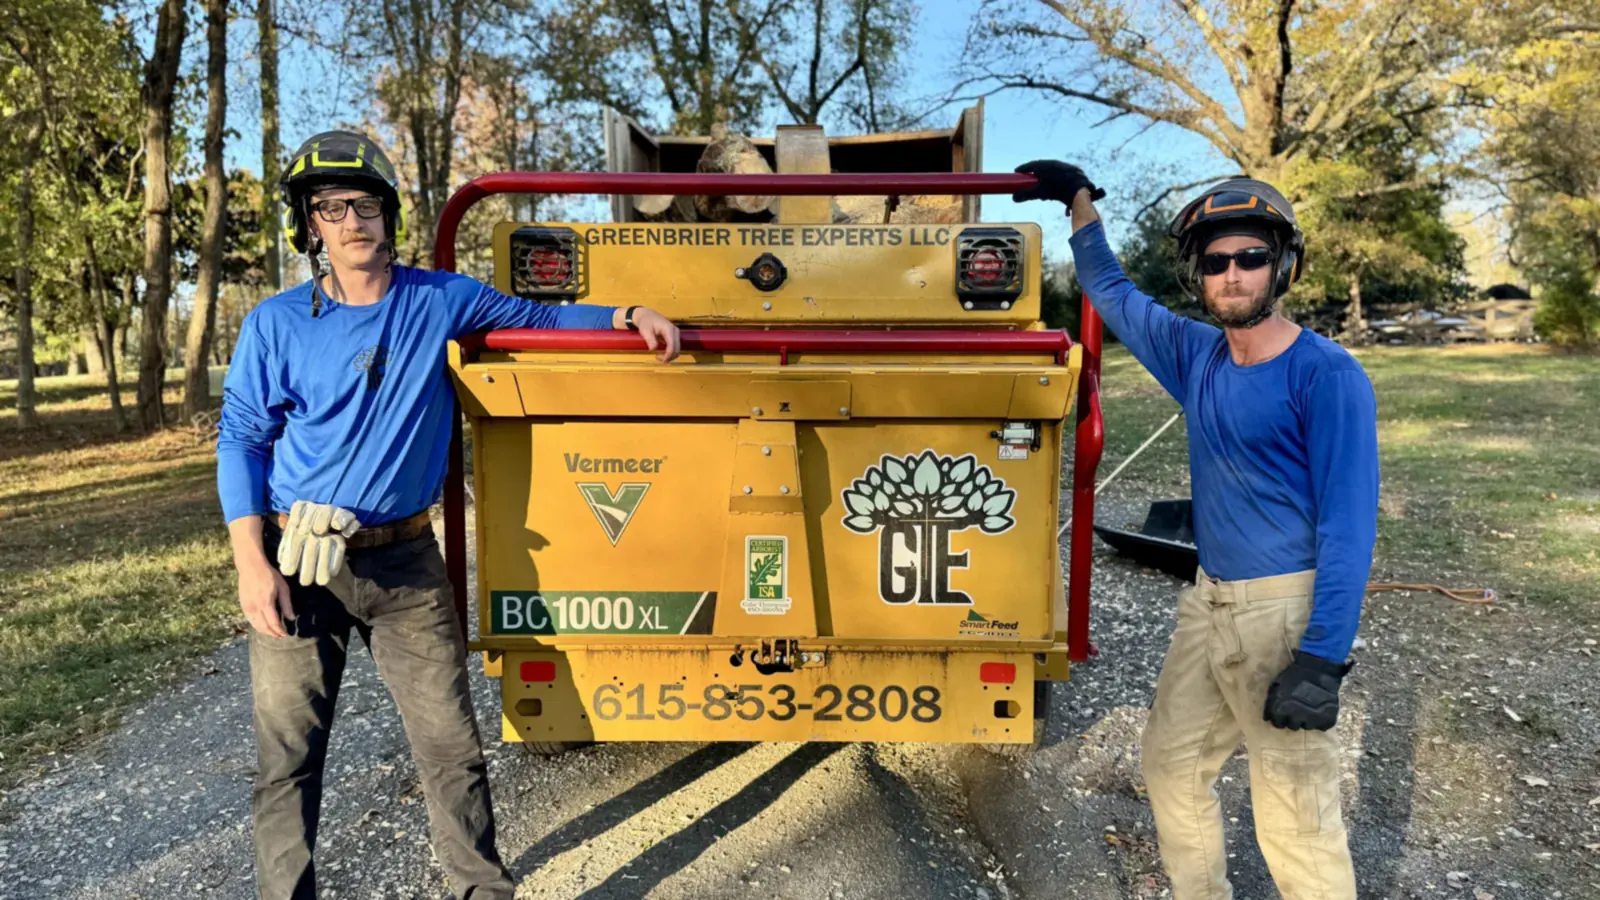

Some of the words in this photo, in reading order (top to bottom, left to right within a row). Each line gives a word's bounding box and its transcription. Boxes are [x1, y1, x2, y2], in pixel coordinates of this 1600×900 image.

[584, 227, 731, 246] GREENBRIER
[738, 228, 796, 246] TREE
[801, 228, 902, 246] EXPERTS
[910, 228, 950, 246] LLC
[563, 452, 663, 473] Vermeer
[759, 586, 776, 598] ISA
[592, 683, 942, 723] 615-853-2808
